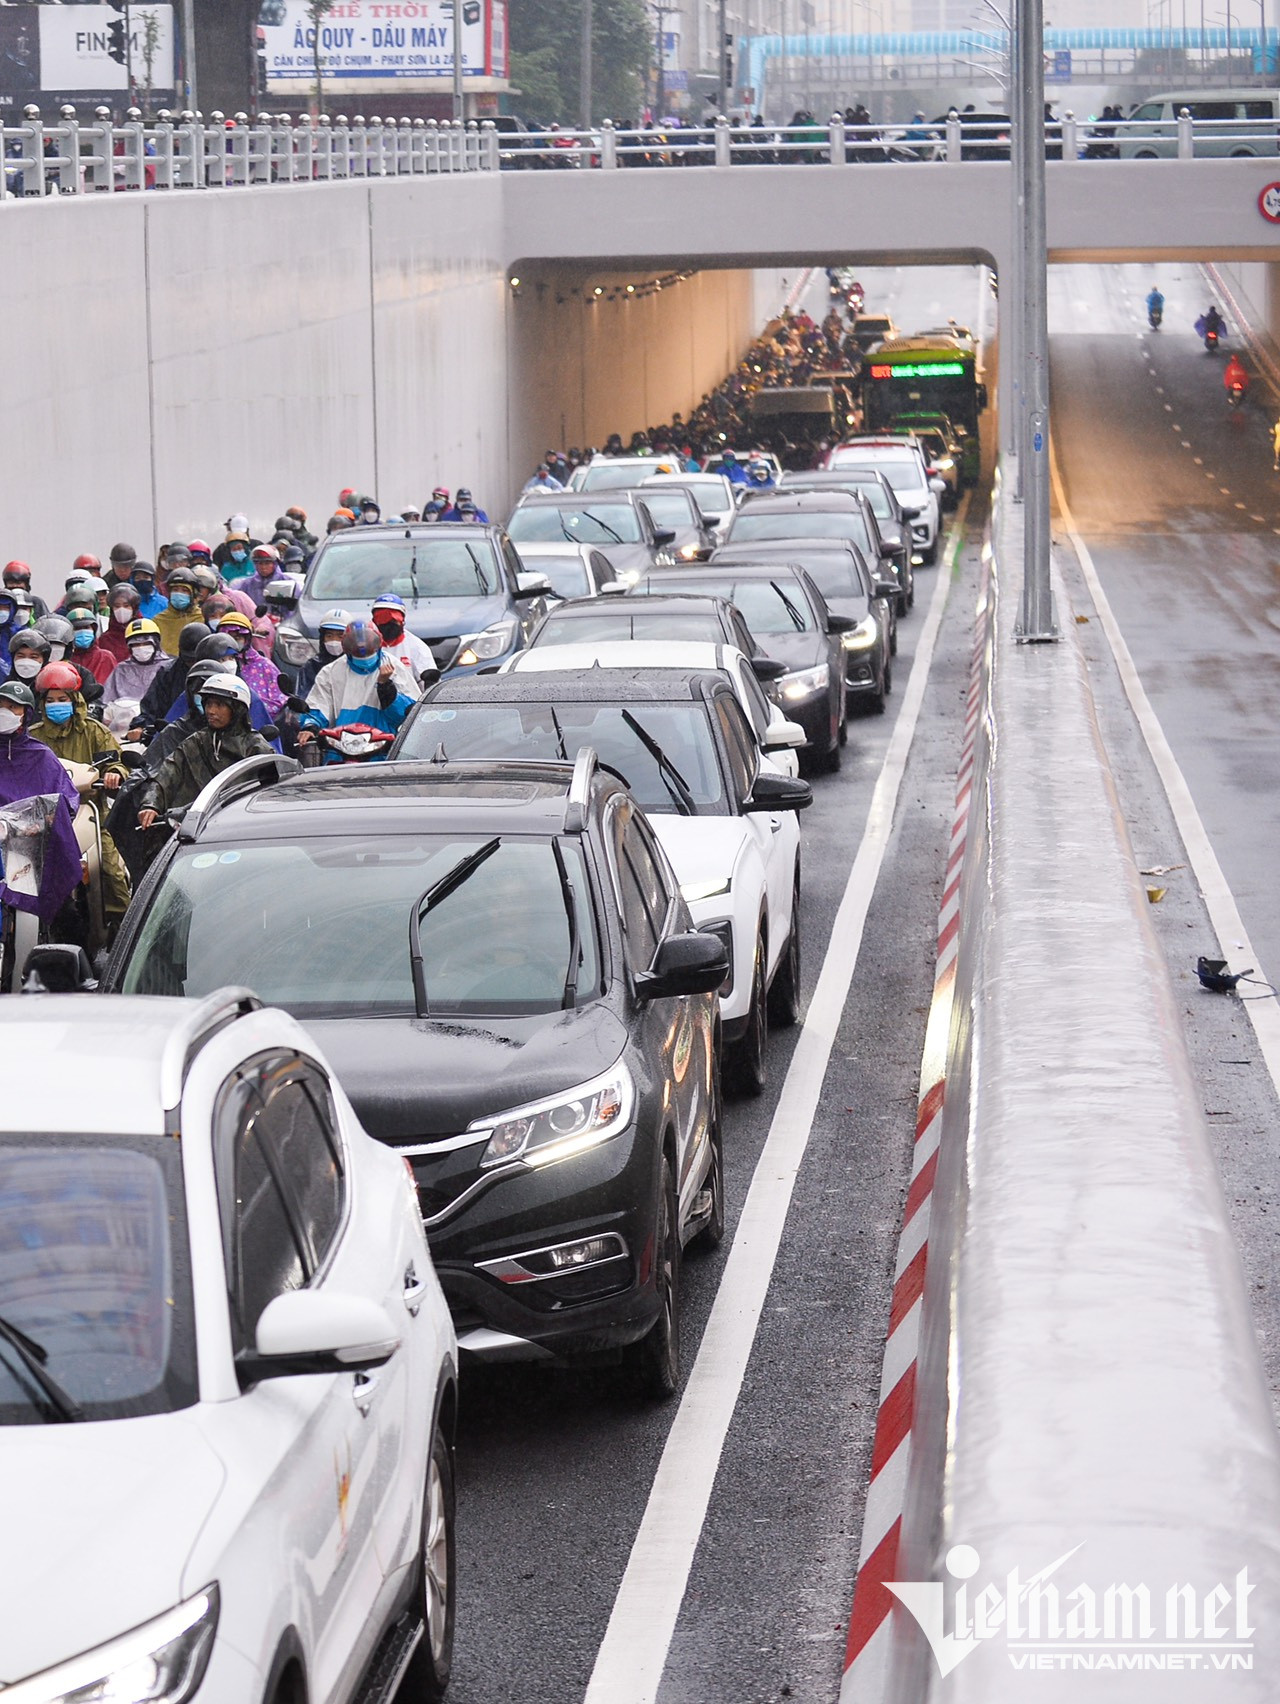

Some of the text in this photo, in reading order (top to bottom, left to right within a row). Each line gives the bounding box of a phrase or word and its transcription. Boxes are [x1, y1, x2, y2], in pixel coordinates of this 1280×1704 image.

[322, 27, 355, 50] QUY
[372, 20, 406, 48] DẦU
[411, 22, 448, 48] MÁY
